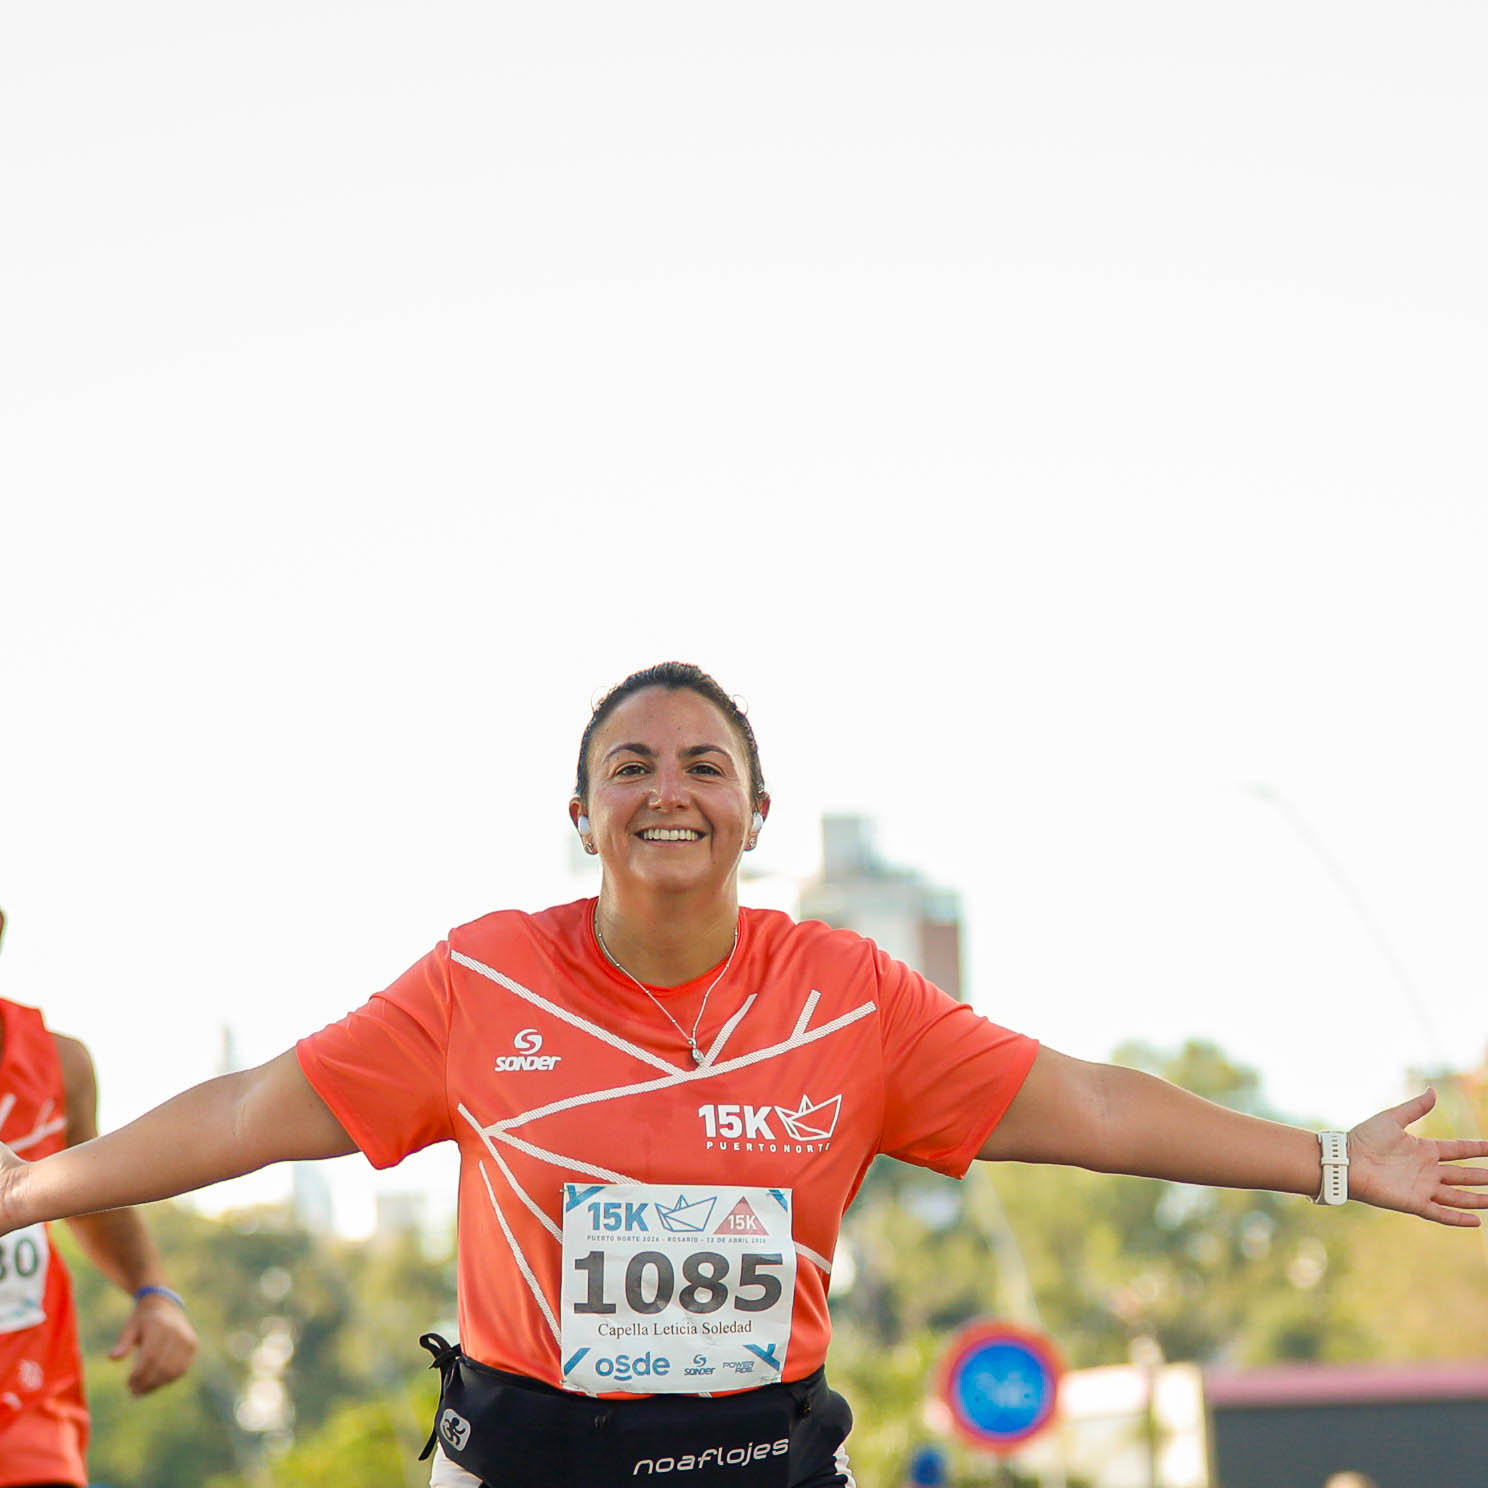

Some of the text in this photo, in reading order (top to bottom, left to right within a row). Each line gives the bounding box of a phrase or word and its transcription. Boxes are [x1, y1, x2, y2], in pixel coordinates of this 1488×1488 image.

[698, 1104, 776, 1140] 15K
[706, 1141, 777, 1152] PUERTO
[587, 1202, 649, 1231] 15K
[727, 1214, 758, 1230] 15K
[573, 1250, 784, 1315] 1085
[598, 1320, 752, 1340] Capella Leticia Soledad
[595, 1351, 671, 1377] osde
[722, 1360, 755, 1368] POWER
[633, 1438, 790, 1475] noaflojes
